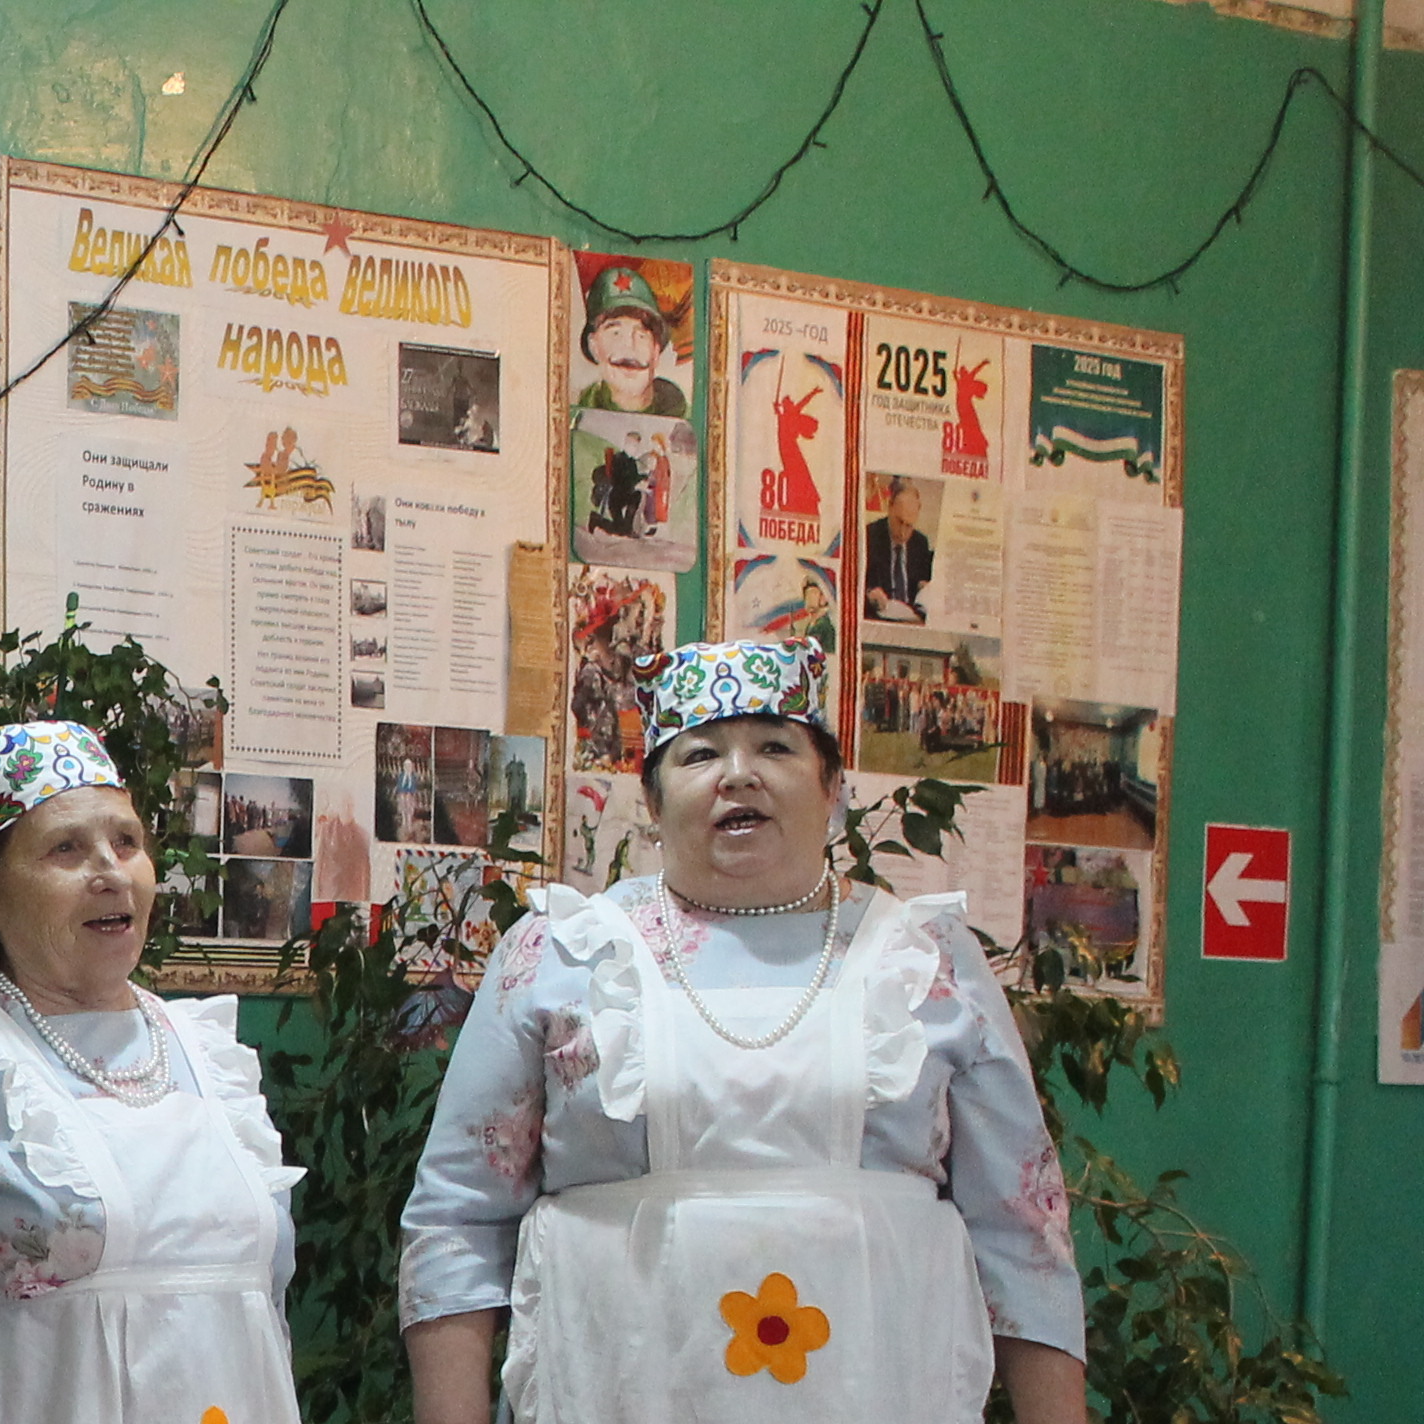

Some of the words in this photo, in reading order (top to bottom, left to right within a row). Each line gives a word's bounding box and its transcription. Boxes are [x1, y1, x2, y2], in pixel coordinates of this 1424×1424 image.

[67, 207, 193, 288] Великая
[209, 237, 329, 305] победа
[339, 254, 472, 329] великого
[763, 318, 793, 336] 2025
[217, 322, 348, 396] народа
[876, 343, 948, 397] 2025
[82, 450, 108, 464] Они
[110, 455, 169, 472] защищали
[82, 474, 125, 493] Родину
[127, 482, 135, 492] в
[82, 501, 145, 518] сражениях
[394, 498, 413, 509] Они
[447, 504, 479, 519] победу
[394, 518, 416, 530] тылу
[759, 517, 820, 544] ПОБЕДА!
